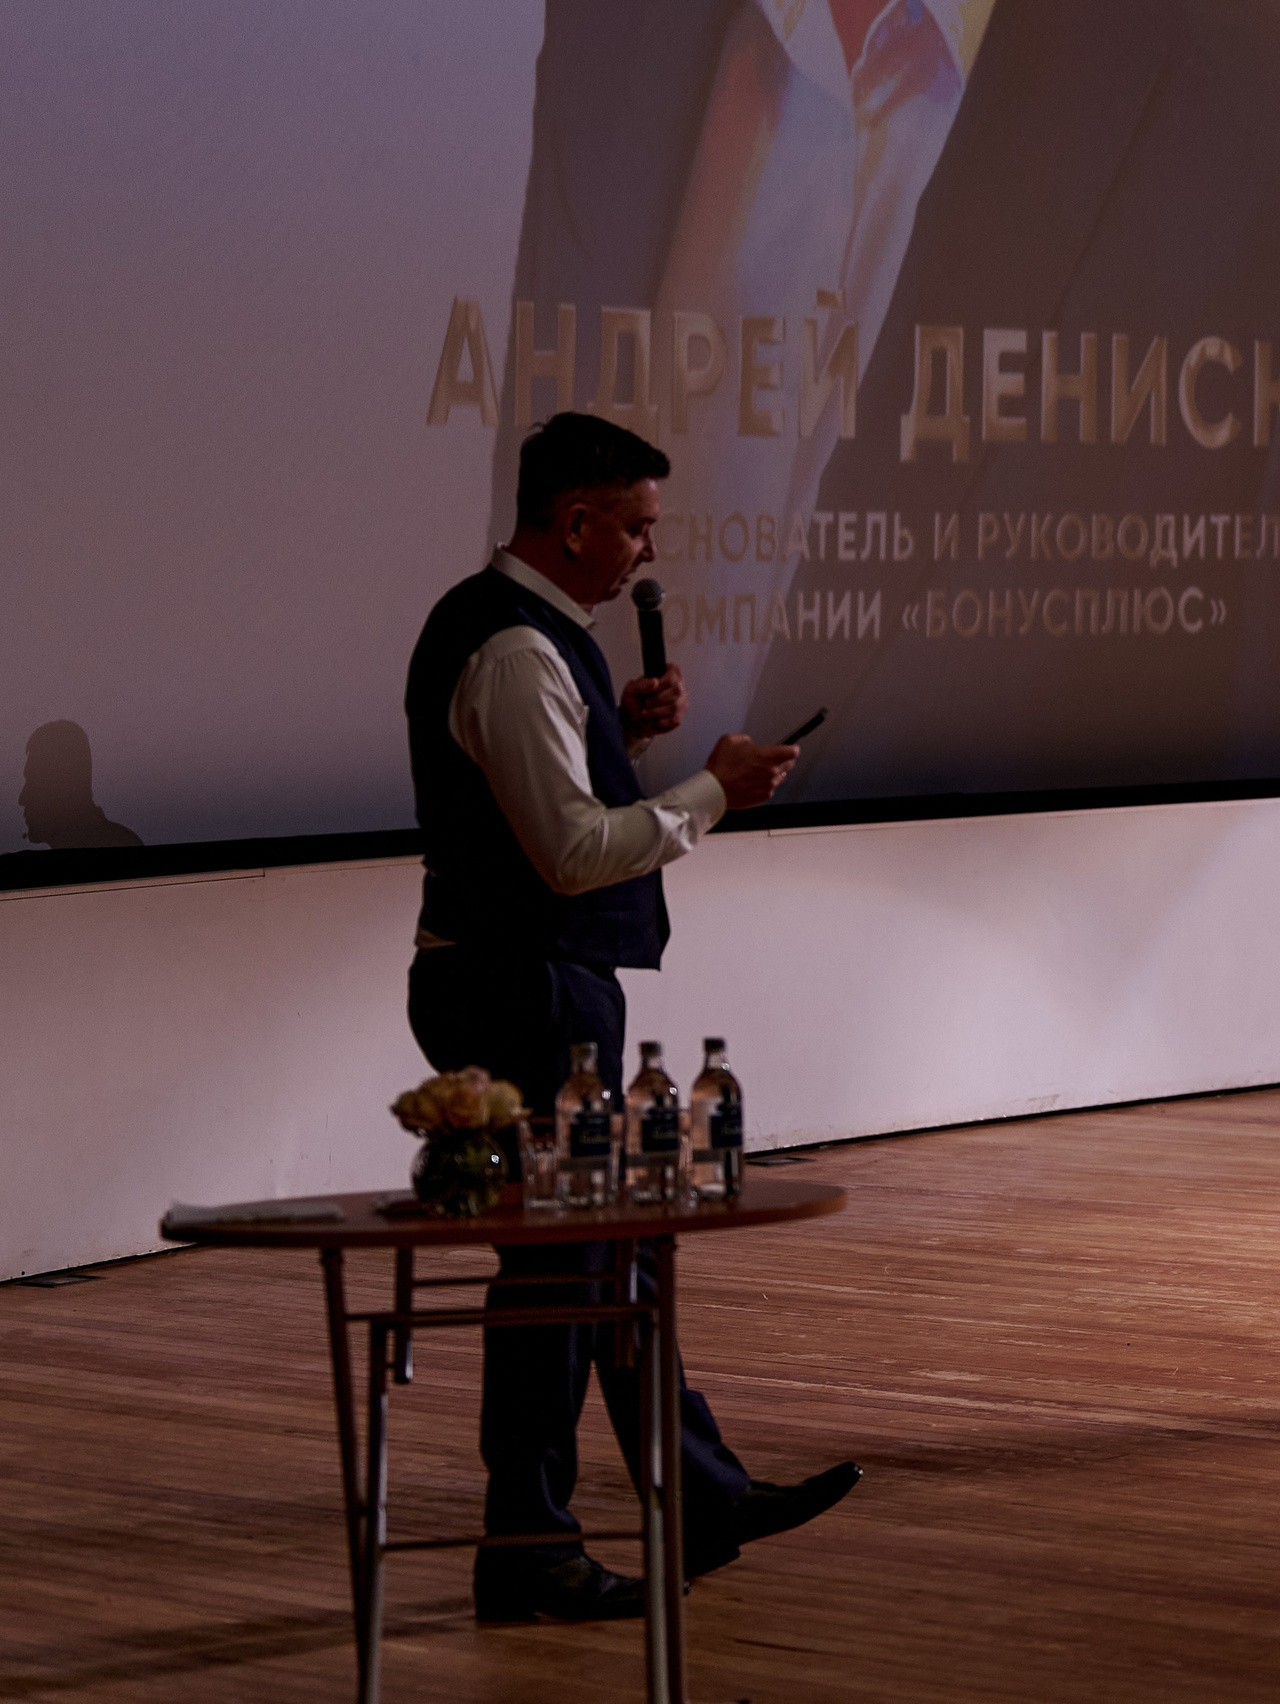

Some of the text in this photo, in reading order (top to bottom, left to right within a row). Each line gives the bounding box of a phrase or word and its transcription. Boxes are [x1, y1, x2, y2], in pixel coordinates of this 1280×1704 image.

[426, 288, 860, 448] АНДРЕЙ
[655, 510, 914, 564] СНОВАТЕЛЬ
[934, 511, 960, 561] И
[662, 586, 1227, 648] ОМПАНИИ «БОНУСПЛЮС»
